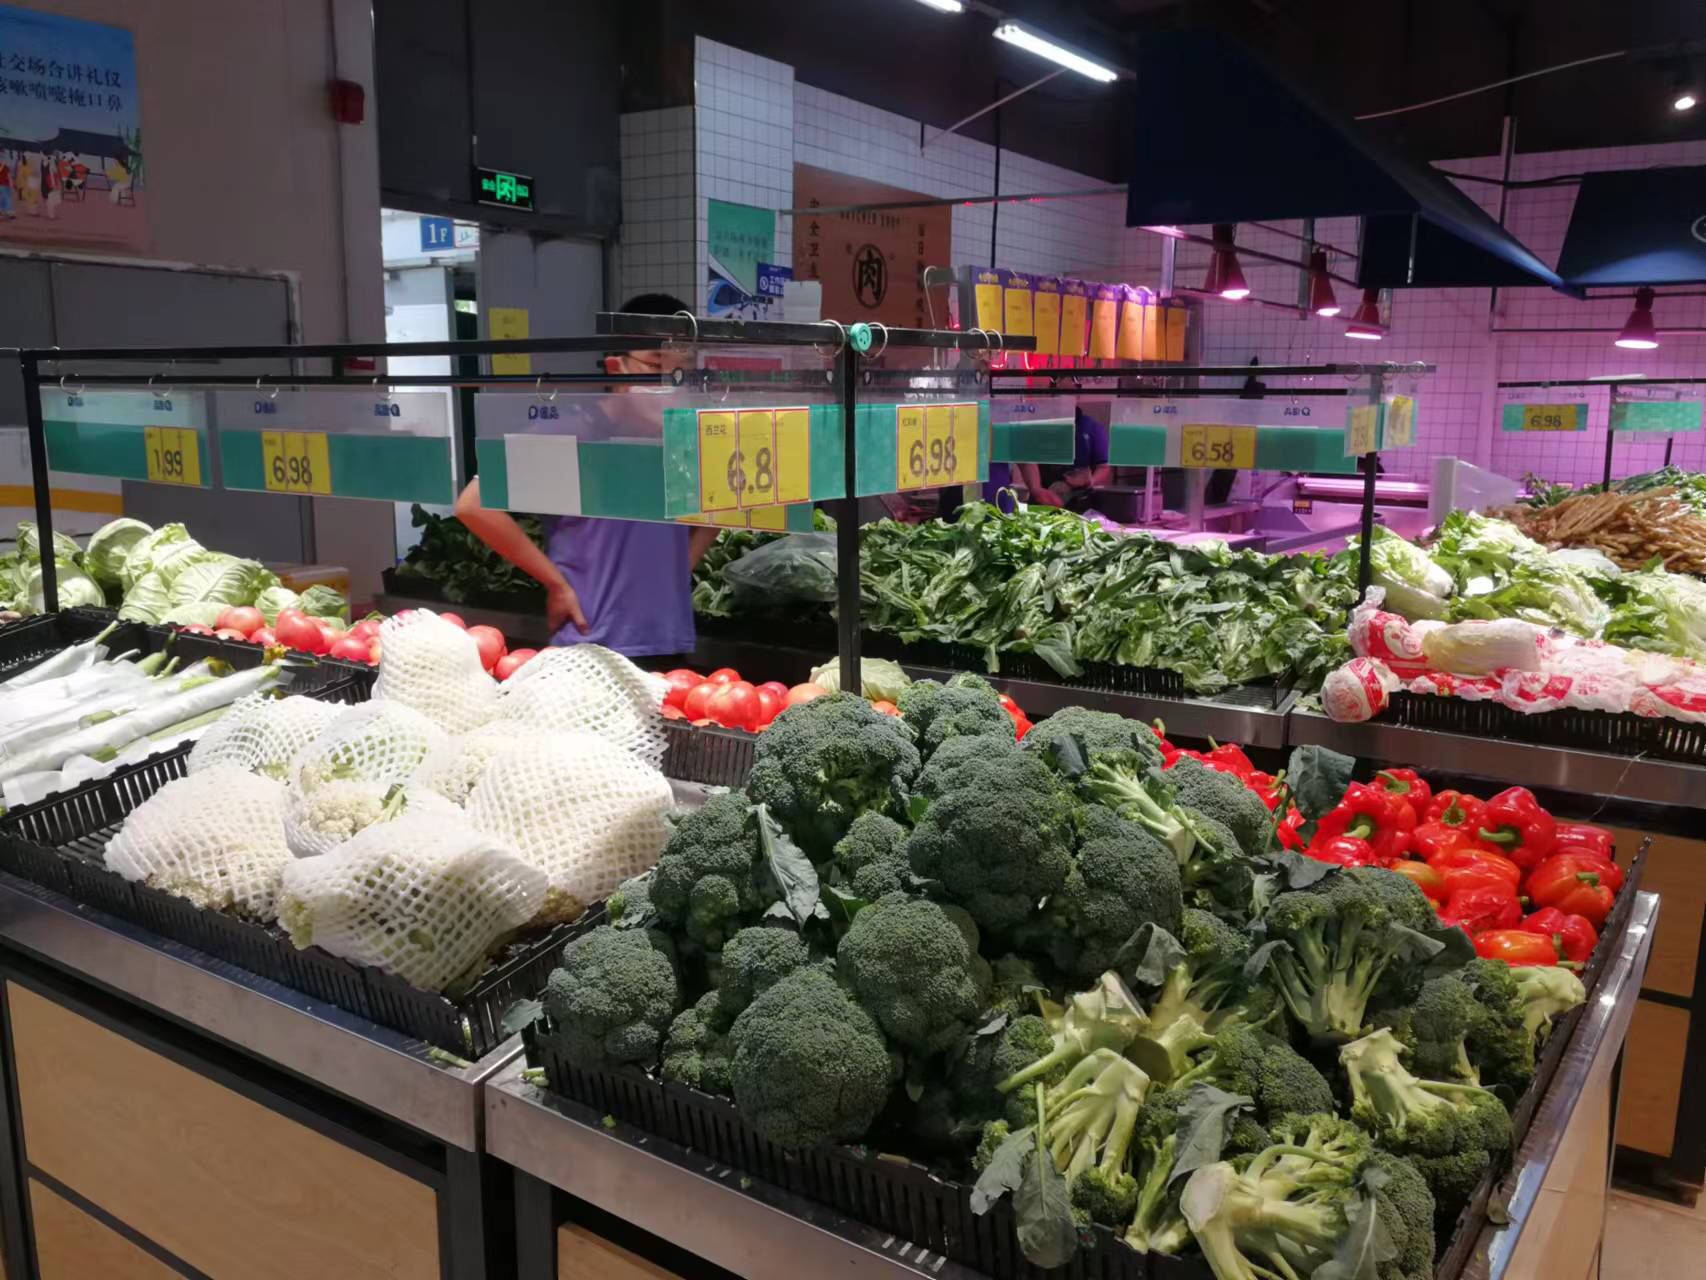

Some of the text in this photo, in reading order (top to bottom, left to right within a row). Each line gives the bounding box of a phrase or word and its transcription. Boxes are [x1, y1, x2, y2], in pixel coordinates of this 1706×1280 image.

[858, 248, 882, 301] 肉
[1530, 414, 1562, 428] 6.98
[727, 447, 773, 493] 6.8
[910, 436, 957, 477] 6.98
[1191, 441, 1234, 463] 6.98
[272, 455, 313, 486] 6.98
